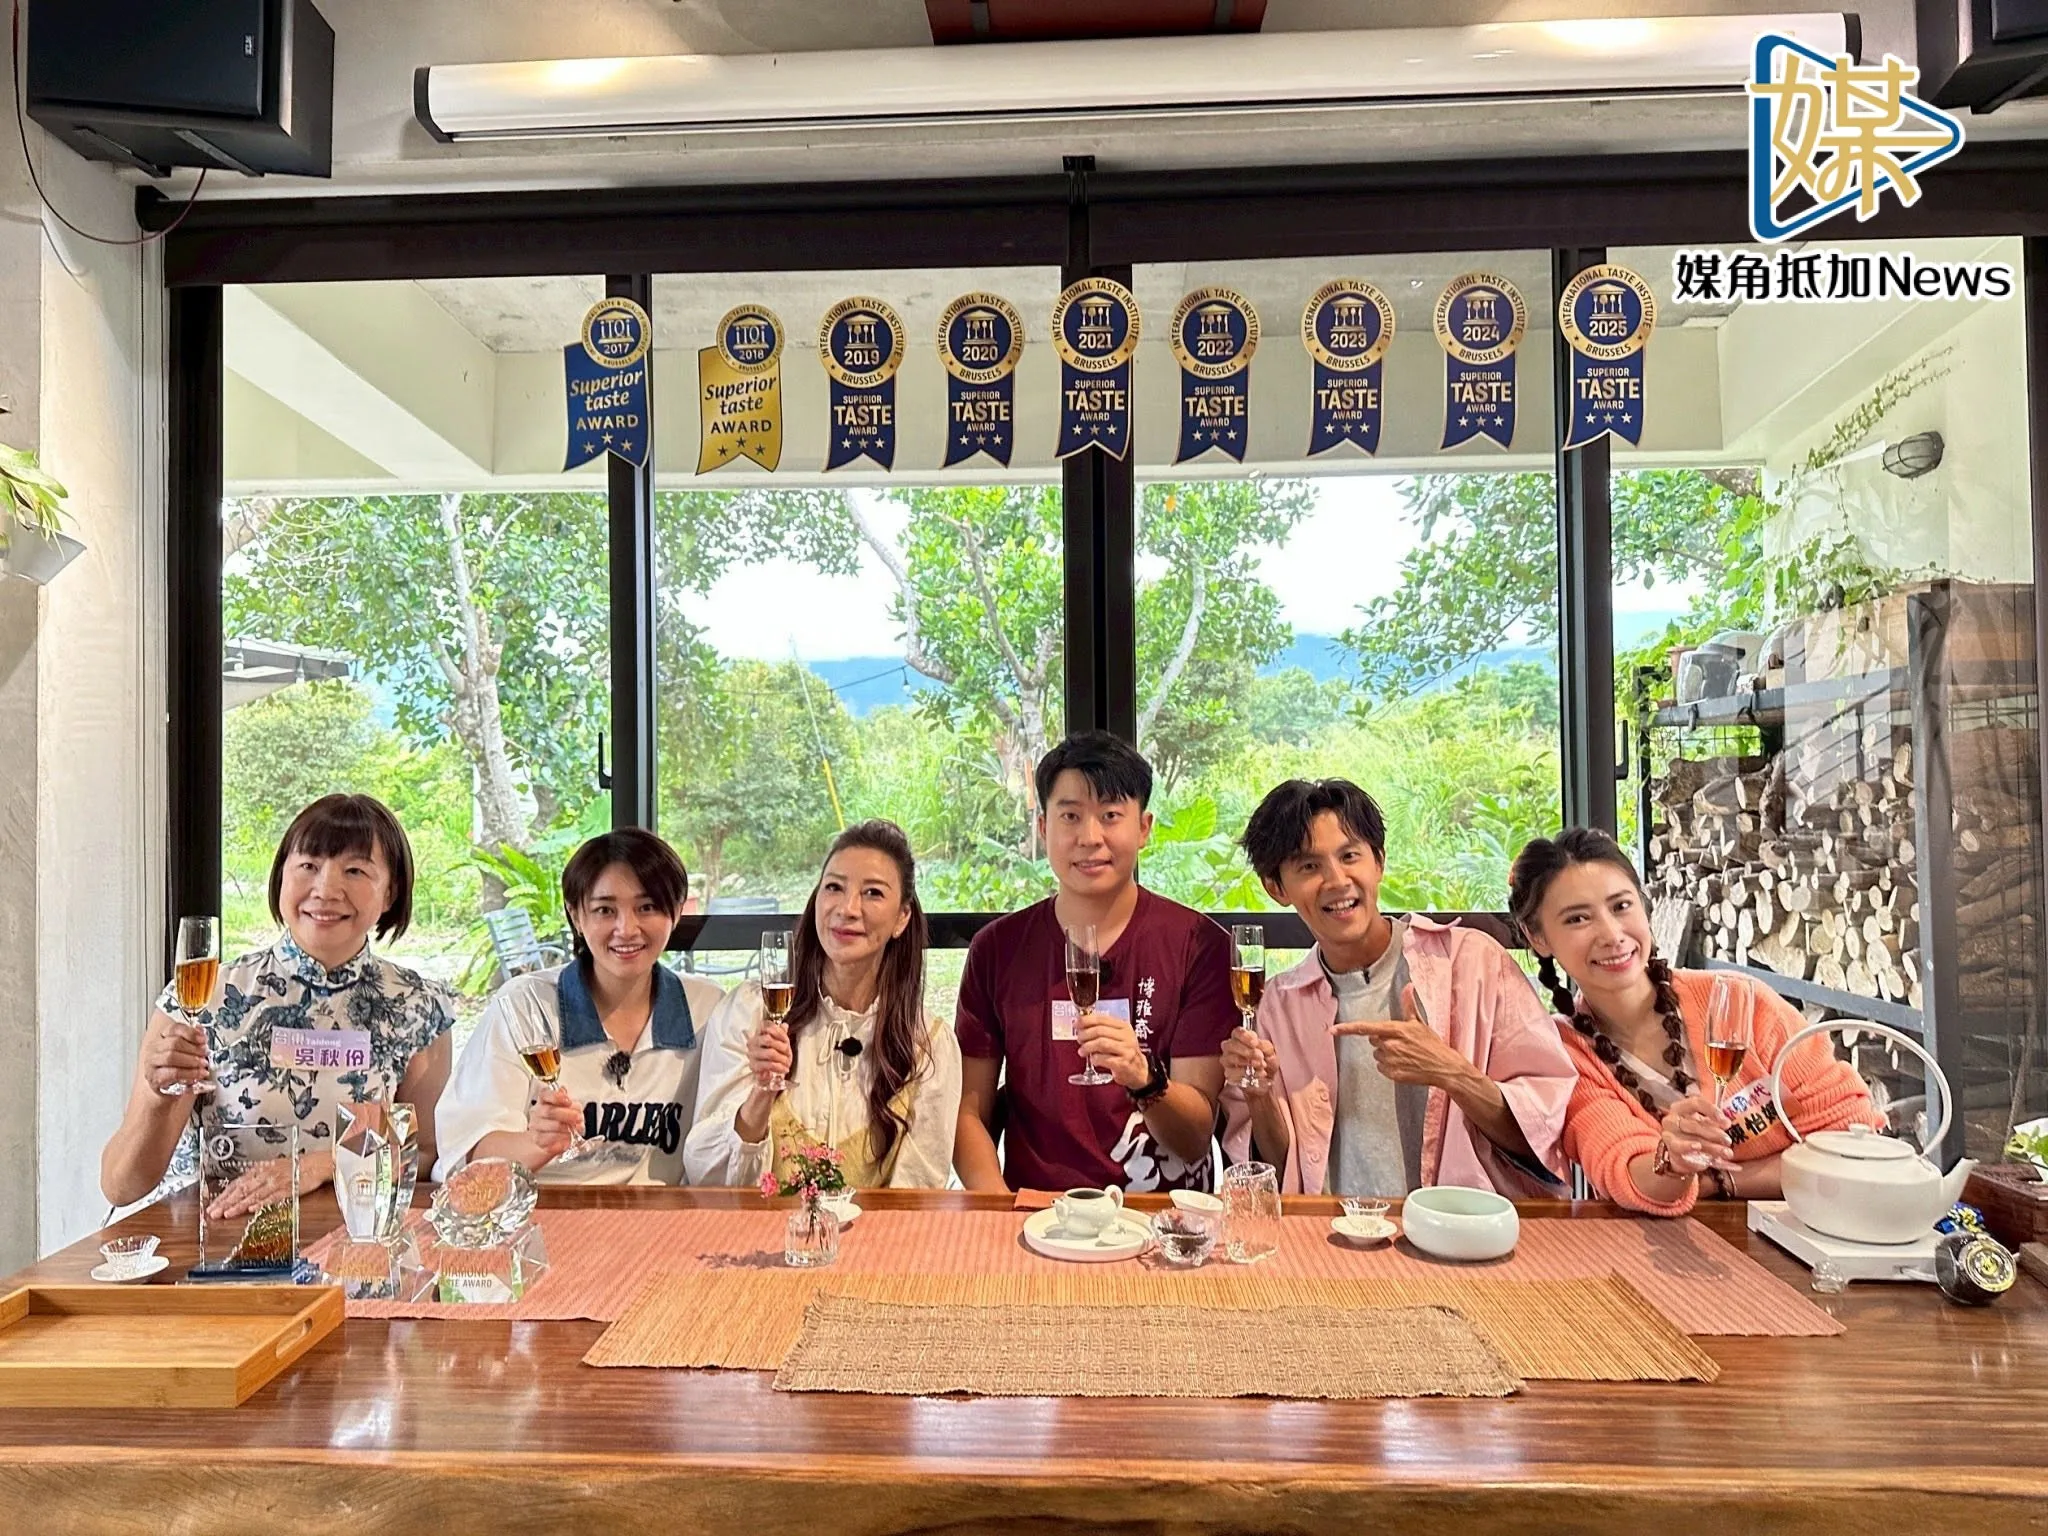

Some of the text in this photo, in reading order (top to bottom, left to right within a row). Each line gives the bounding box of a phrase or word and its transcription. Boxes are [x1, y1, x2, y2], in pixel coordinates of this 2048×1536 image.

[1437, 274, 1526, 335] INTERNATIONAL TASTE INSTITUTE
[1563, 268, 1653, 329] INTERNATIONAL TASTE INSTITUTE
[1052, 281, 1140, 340] INTERNATIONAL TASTE INSTITUTE
[1304, 282, 1393, 341] INTERNATIONAL TASTE INSTITUTE
[938, 295, 1023, 354] INTERNATIONAL TASTE INSTITUTE
[1172, 289, 1258, 350] INTERNATIONAL TASTE INSTITUTE
[819, 299, 857, 358] INTERNATIONAL
[861, 299, 887, 314] TASTE
[886, 312, 904, 358] INSTITUTE
[1463, 326, 1499, 341] 2024
[1589, 321, 1627, 336] 2025
[1079, 333, 1112, 349] 2021
[1330, 333, 1366, 348] 2023
[604, 343, 630, 354] 2017
[739, 350, 764, 360] 2018
[963, 346, 997, 361] 2020
[1198, 341, 1233, 356] 2022
[1459, 348, 1503, 361] BRUSSELS
[1586, 343, 1631, 357] BRUSSELS
[844, 350, 879, 365] 2019
[1073, 356, 1117, 369] BRUSSELS
[1326, 355, 1371, 368] BRUSSELS
[960, 368, 1002, 381] BRUSSELS
[1193, 362, 1236, 376] BRUSSELS
[1460, 372, 1501, 381] SUPERIOR
[1587, 368, 1629, 377] SUPERIOR
[570, 370, 643, 397] Superior
[841, 372, 883, 385] BRUSSELS
[1075, 380, 1115, 389] SUPERIOR
[1328, 379, 1368, 388] SUPERIOR
[704, 376, 777, 401] Superior
[961, 391, 1000, 400] SUPERIOR
[1195, 386, 1234, 395] SUPERIOR
[1451, 382, 1512, 403] TASTE
[1577, 378, 1640, 399] TASTE
[584, 390, 630, 412] taste
[720, 396, 764, 415] taste
[843, 395, 882, 404] SUPERIOR
[1065, 391, 1125, 411] TASTE
[1185, 396, 1244, 417] TASTE
[1317, 389, 1377, 410] TASTE
[1593, 400, 1624, 410] AWARD
[834, 405, 891, 425] TASTE
[952, 402, 1010, 422] TASTE
[1333, 411, 1362, 420] AWARD
[1466, 404, 1496, 413] AWARD
[576, 414, 639, 431] AWARD
[1080, 412, 1109, 421] AWARD
[1200, 418, 1229, 427] AWARD
[711, 419, 772, 434] AWARD
[849, 426, 877, 435] AWARD
[967, 423, 995, 432] AWARD
[463, 1279, 492, 1288] AWARD
